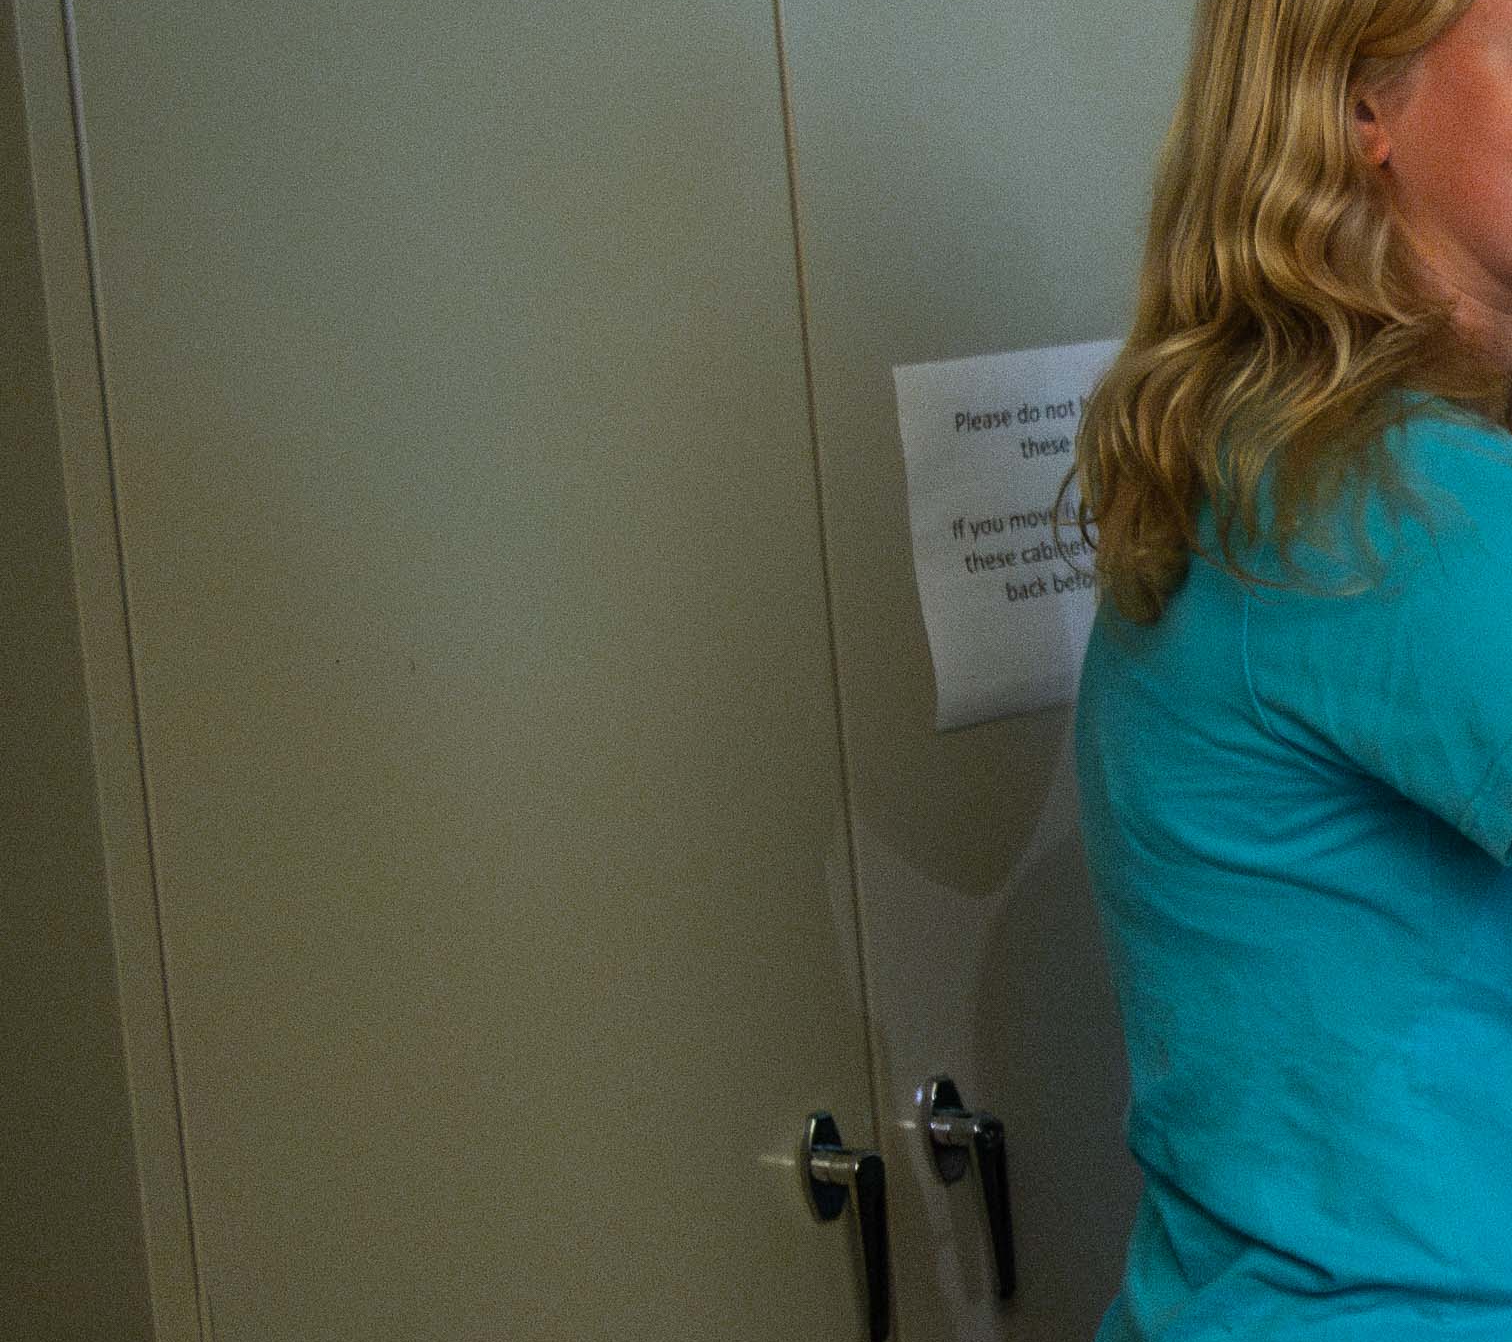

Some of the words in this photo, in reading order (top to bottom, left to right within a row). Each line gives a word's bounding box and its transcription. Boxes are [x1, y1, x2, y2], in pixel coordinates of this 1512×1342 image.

[955, 410, 1011, 433] Please
[1017, 403, 1040, 424] do
[1045, 400, 1076, 420] not
[1020, 435, 1071, 459] these
[952, 517, 965, 540] If
[969, 517, 1004, 540] you
[965, 551, 1017, 574] these
[1005, 577, 1047, 603] back
[1053, 573, 1093, 594] befo
